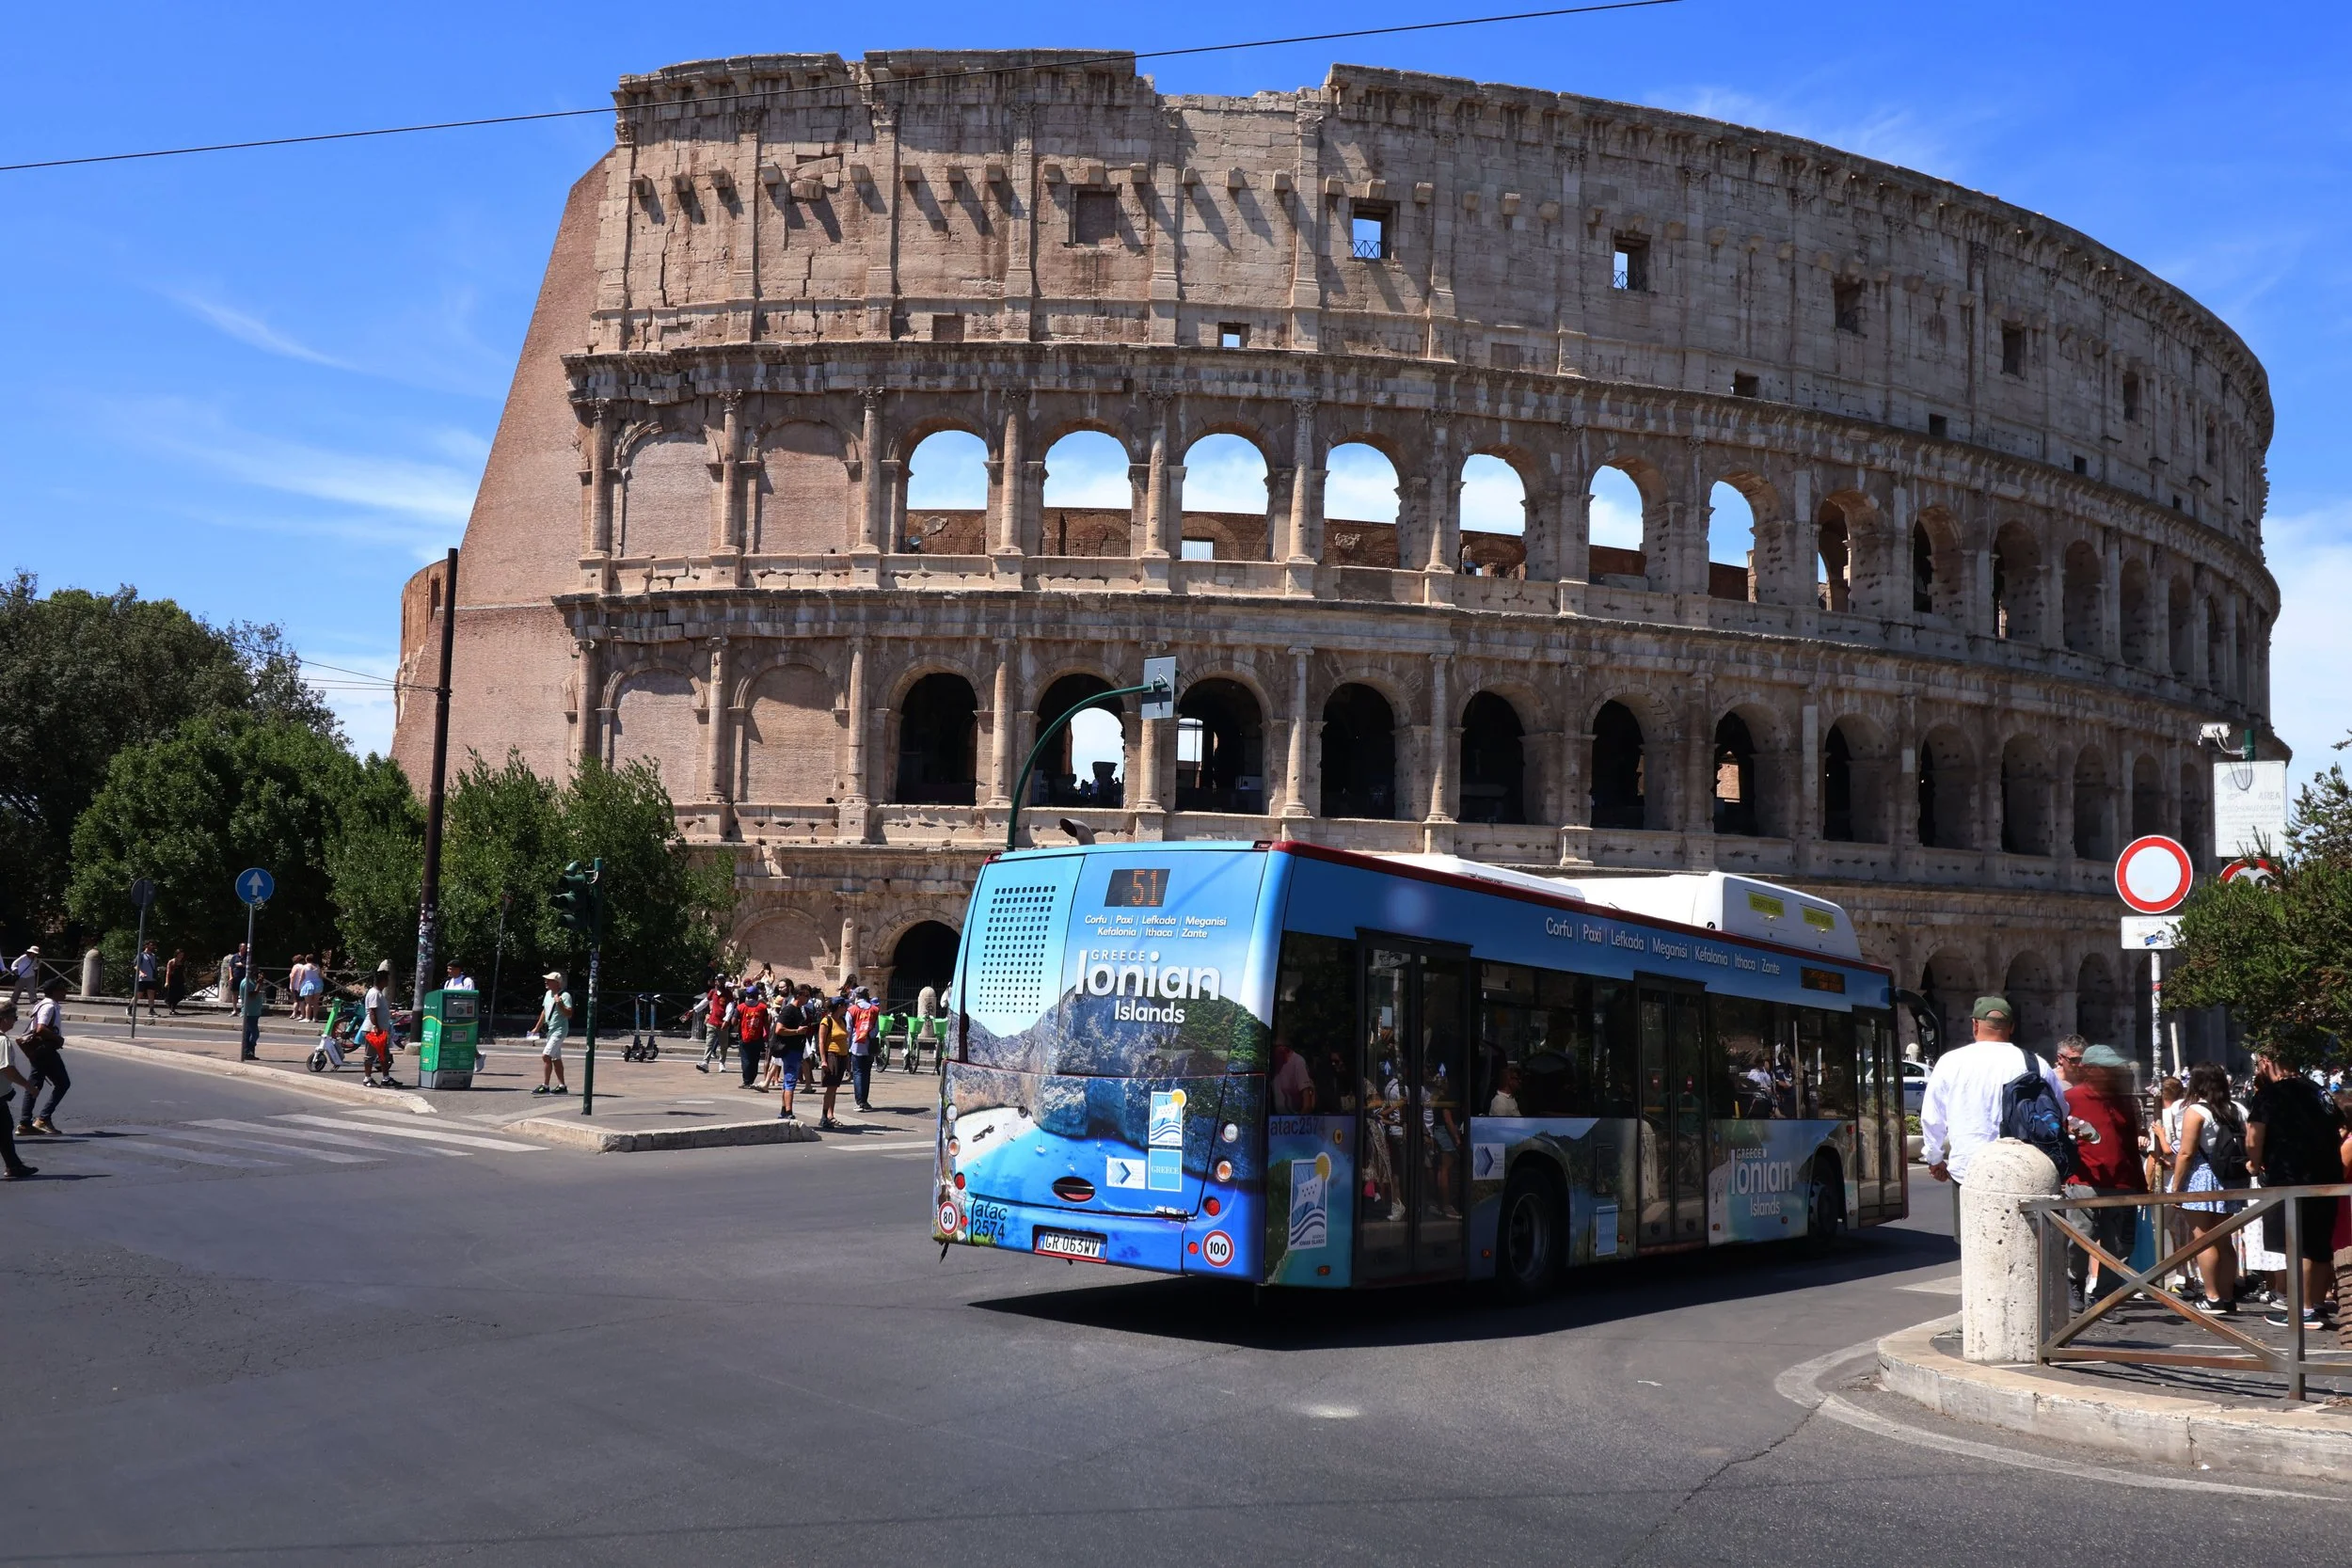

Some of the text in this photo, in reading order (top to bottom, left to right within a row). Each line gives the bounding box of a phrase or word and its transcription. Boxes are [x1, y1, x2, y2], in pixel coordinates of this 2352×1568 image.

[1132, 869, 1158, 906] 51
[1085, 914, 1227, 927] Corfu Paxi Lefkada Meganisi
[1097, 927, 1208, 939] Kefalonia Ithaca Zante
[1090, 949, 1146, 961] GREECE
[1546, 916, 1780, 975] Corfu Paxi Lefkada Meganisi Kefalonia Ithaca Zante
[1074, 949, 1221, 1001] Ionian
[1114, 1000, 1185, 1023] Islands
[1736, 1148, 1762, 1159] GREECE
[1151, 1165, 1180, 1175] GREECE
[1730, 1148, 1793, 1195] Ionian
[975, 1202, 1008, 1221] atac
[1750, 1195, 1781, 1217] Islands
[943, 1212, 954, 1225] 80
[974, 1219, 1006, 1241] 2574
[1209, 1241, 1227, 1257] 100
